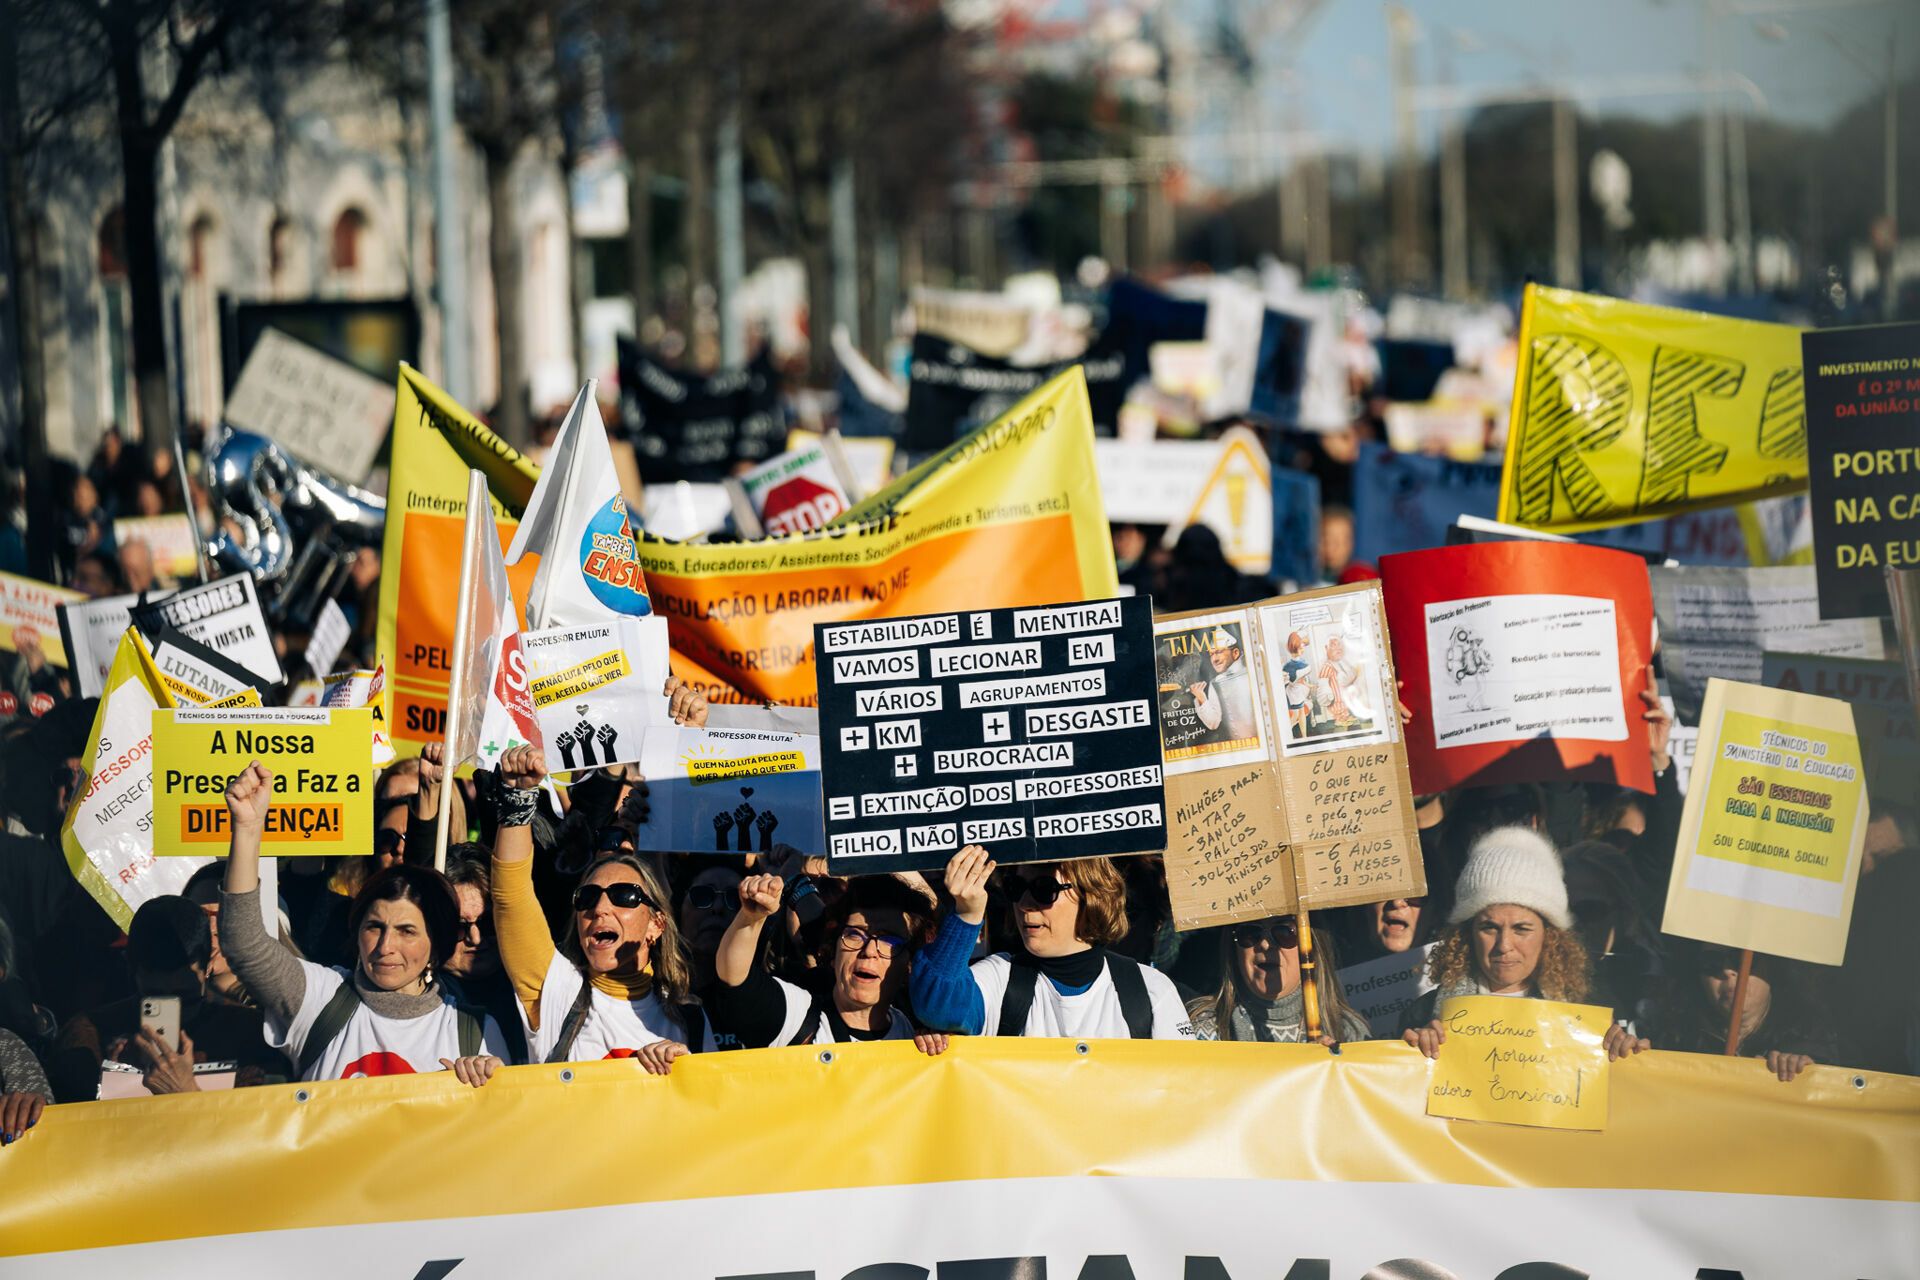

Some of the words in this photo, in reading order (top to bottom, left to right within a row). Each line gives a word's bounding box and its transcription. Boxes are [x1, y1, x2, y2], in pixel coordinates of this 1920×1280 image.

[1819, 359, 1909, 376] INVESTIMENTO
[1858, 379, 1866, 395] É
[1870, 381, 1882, 394] O
[1835, 404, 1857, 418] DA
[1860, 398, 1910, 416] UNIÃO
[1835, 497, 1881, 525] NA
[780, 550, 861, 568] Assistentes
[1037, 491, 1069, 513] etc.)
[1836, 543, 1878, 568] DA
[763, 586, 852, 614] LABORAL
[891, 565, 912, 595] ME
[575, 632, 587, 641] EM
[588, 628, 610, 639] LUTA!
[828, 617, 958, 647] ESTABILIDADE
[973, 615, 984, 637] É
[1020, 606, 1120, 634] MENTIRA!
[546, 674, 563, 687] NÃO
[564, 667, 582, 681] LUTA
[582, 661, 602, 674] PELO
[603, 653, 620, 666] QUE
[837, 654, 915, 679] VAMOS
[938, 647, 1038, 673] LECIONAR
[1072, 642, 1104, 660] EM
[555, 684, 582, 700] ACEITA
[581, 682, 588, 690] O
[861, 690, 937, 713] VÁRIOS
[969, 676, 1103, 705] AGRUPAMENTOS
[230, 711, 273, 721] MINISTÉRIO
[1171, 699, 1181, 709] O
[879, 724, 917, 747] KM
[1028, 703, 1146, 735] DESGASTE
[1179, 716, 1197, 726] OZ
[210, 730, 228, 754] A
[236, 730, 315, 754] Nossa
[708, 731, 756, 740] PROFESSOR
[757, 733, 770, 741] EM
[771, 734, 793, 743] LUTA!
[1763, 731, 1809, 752] TÉCNICOS
[1812, 741, 1828, 755] DO
[694, 761, 717, 770] QUEM
[718, 758, 736, 768] NÃO
[737, 756, 758, 766] LUTA
[758, 754, 779, 763] PELO
[780, 753, 797, 761] QUE
[938, 743, 1070, 770] BUROCRACIA
[1313, 759, 1334, 775] EU
[1724, 744, 1782, 766] MINISTÉRIO
[1785, 756, 1800, 769] DA
[1804, 758, 1855, 781] EDUCAÇÃO
[166, 769, 287, 794] Presea
[298, 769, 339, 793] Faz
[346, 774, 360, 792] a
[722, 768, 752, 779] ACEITA
[752, 767, 758, 775] O
[759, 765, 777, 775] QUE
[778, 763, 799, 772] VIER.
[1231, 769, 1264, 796] PARA:
[1310, 781, 1318, 792] O
[1326, 776, 1350, 790] QUE
[1359, 773, 1377, 783] ME
[864, 788, 966, 814] EXTINÇÃO
[973, 786, 1011, 803] DOS
[1024, 767, 1160, 798] PROFESSORES!
[1314, 785, 1387, 806] PERTENCE
[1738, 776, 1765, 796] SÃO
[1769, 783, 1833, 810] ESSENCIAIS
[188, 807, 340, 839] DIFENÇA!
[1202, 803, 1232, 828] TAP
[1306, 814, 1313, 824] e
[1322, 806, 1347, 827] pelo
[1726, 798, 1757, 817] PARA
[1761, 805, 1771, 821] A
[1776, 807, 1835, 833] INCLUSÃO!
[834, 834, 898, 856] FILHO,
[911, 827, 956, 848] NÃO
[966, 821, 1023, 841] SEJAS
[1038, 808, 1160, 836] PROFESSOR.
[1251, 839, 1269, 857] DOS
[1349, 839, 1393, 857] ANOS
[1713, 834, 1734, 848] SOU
[1737, 837, 1791, 859] EDUCADORA
[1794, 850, 1829, 867] SOCIAL!
[1353, 855, 1401, 872] MESES
[1211, 901, 1218, 911] e
